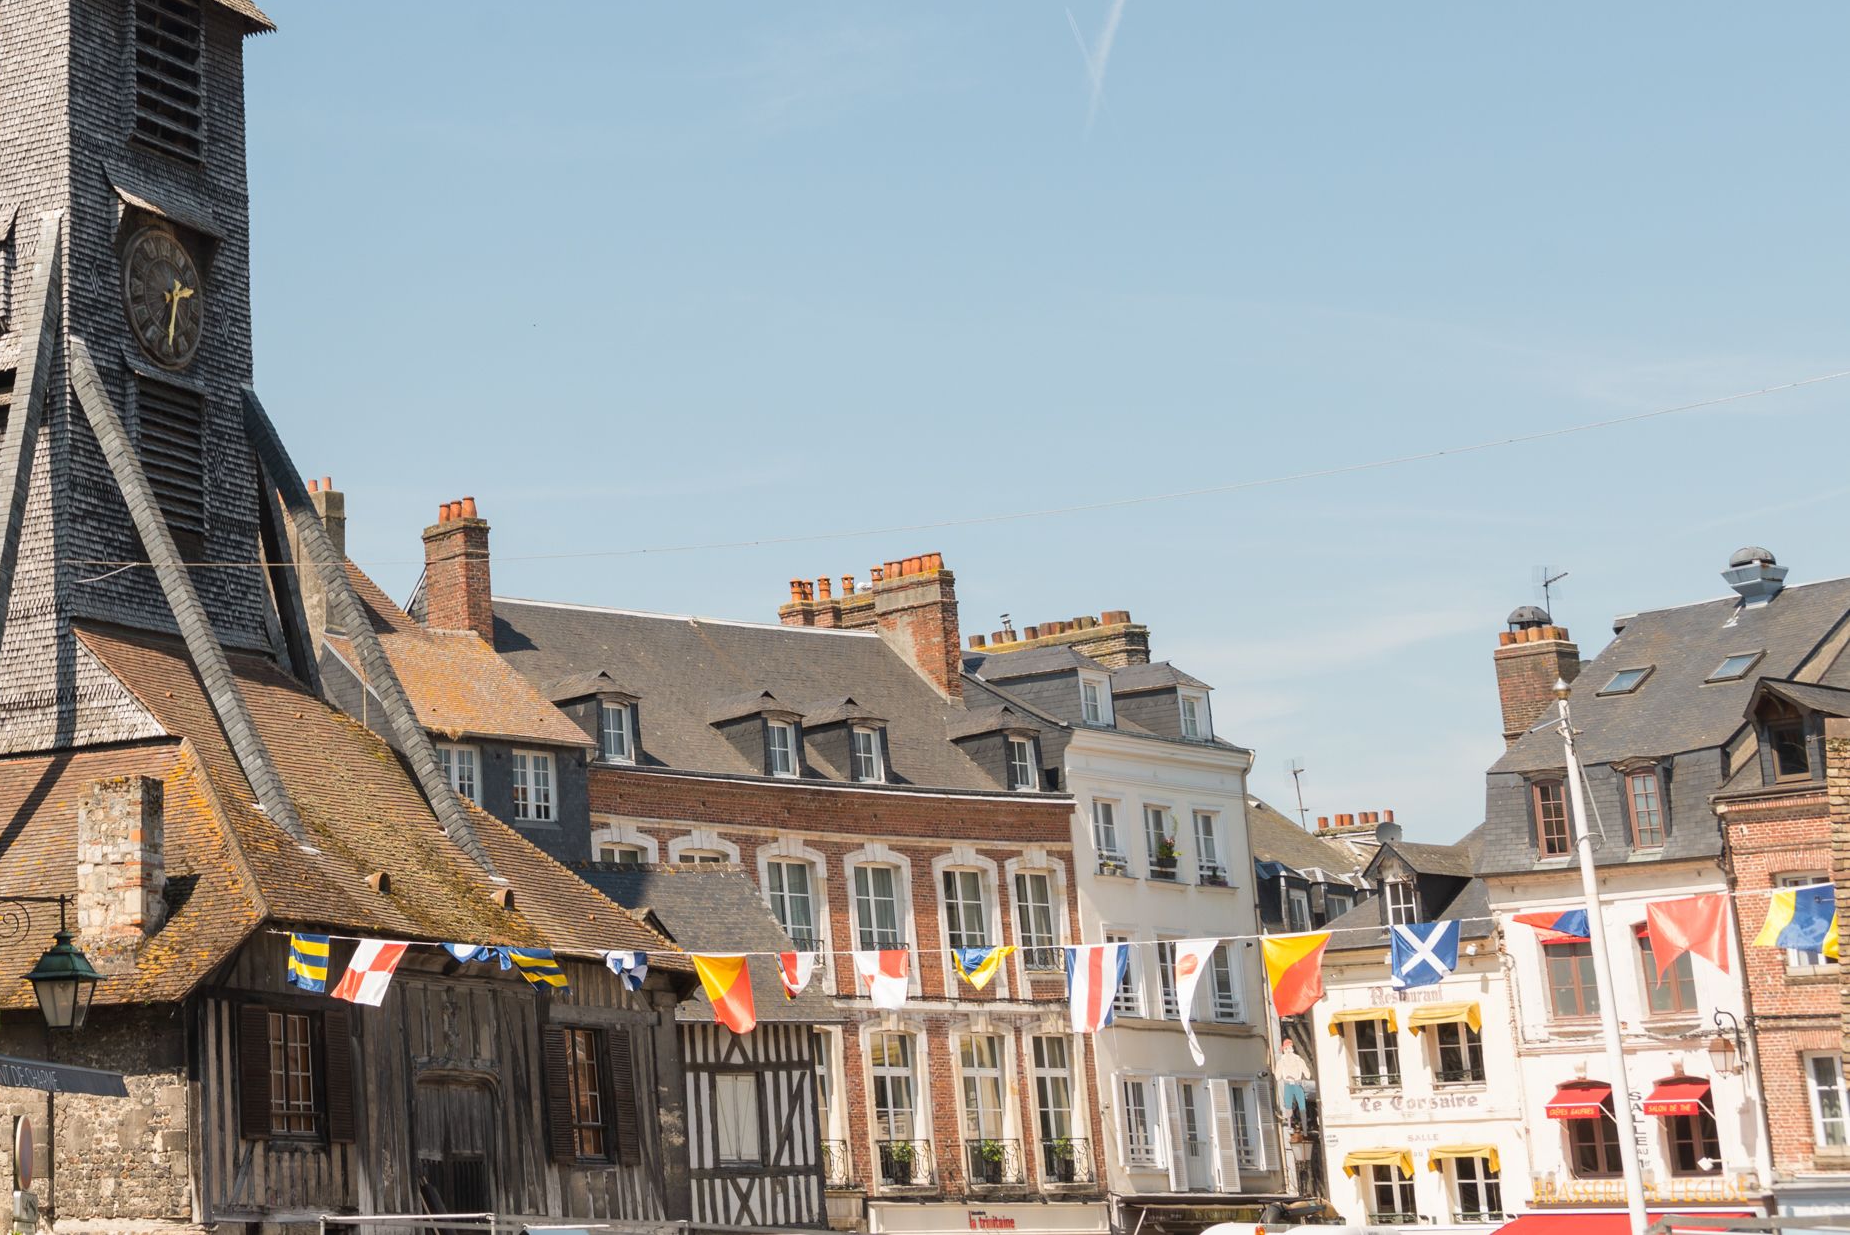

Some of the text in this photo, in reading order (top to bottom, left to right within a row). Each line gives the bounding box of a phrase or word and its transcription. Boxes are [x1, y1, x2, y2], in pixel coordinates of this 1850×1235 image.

[10, 1065, 28, 1087] DE
[25, 1067, 61, 1092] CHARME
[1390, 1093, 1479, 1111] Corsaire
[1648, 1105, 1668, 1113] SALON
[1628, 1091, 1648, 1146] SALLE
[1407, 1133, 1439, 1142] SALLE
[978, 1215, 1015, 1228] trinitaine
